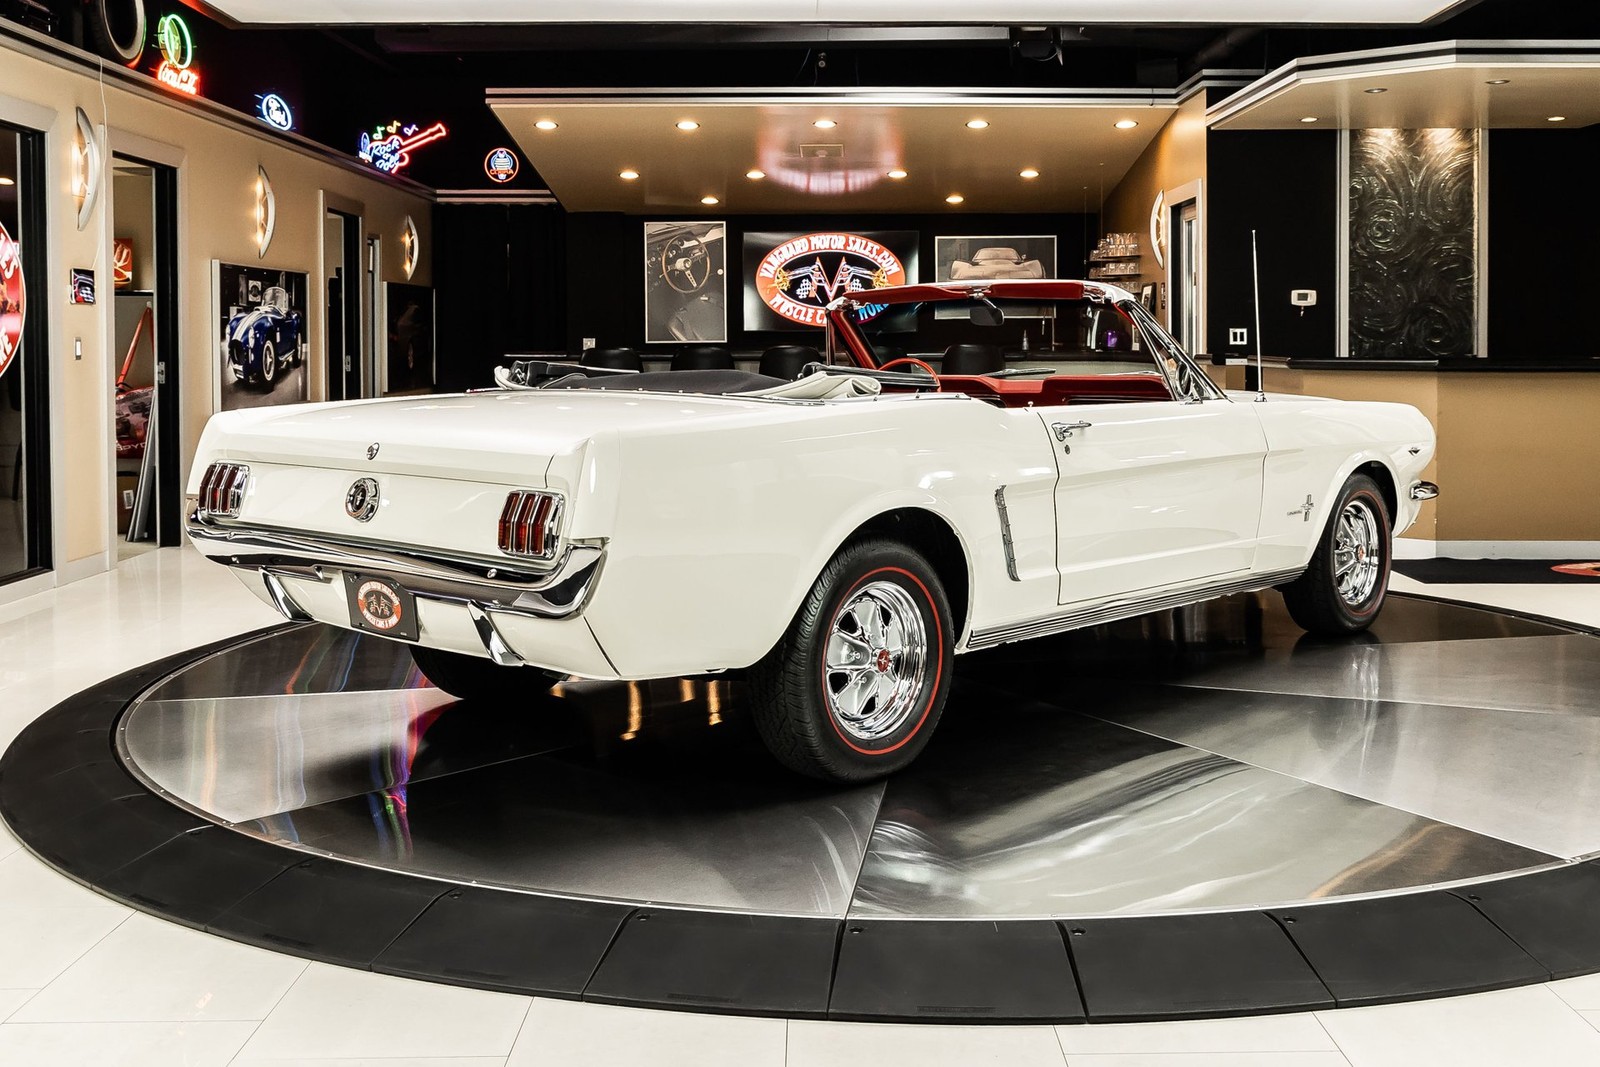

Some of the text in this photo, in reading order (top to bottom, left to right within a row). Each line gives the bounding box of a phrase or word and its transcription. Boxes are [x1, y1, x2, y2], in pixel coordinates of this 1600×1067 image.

[371, 137, 400, 158] Rock
[759, 234, 901, 279] VANGUARD MOTOR SALES.COM
[769, 293, 814, 323] MUSCLE
[858, 303, 890, 321] MOR
